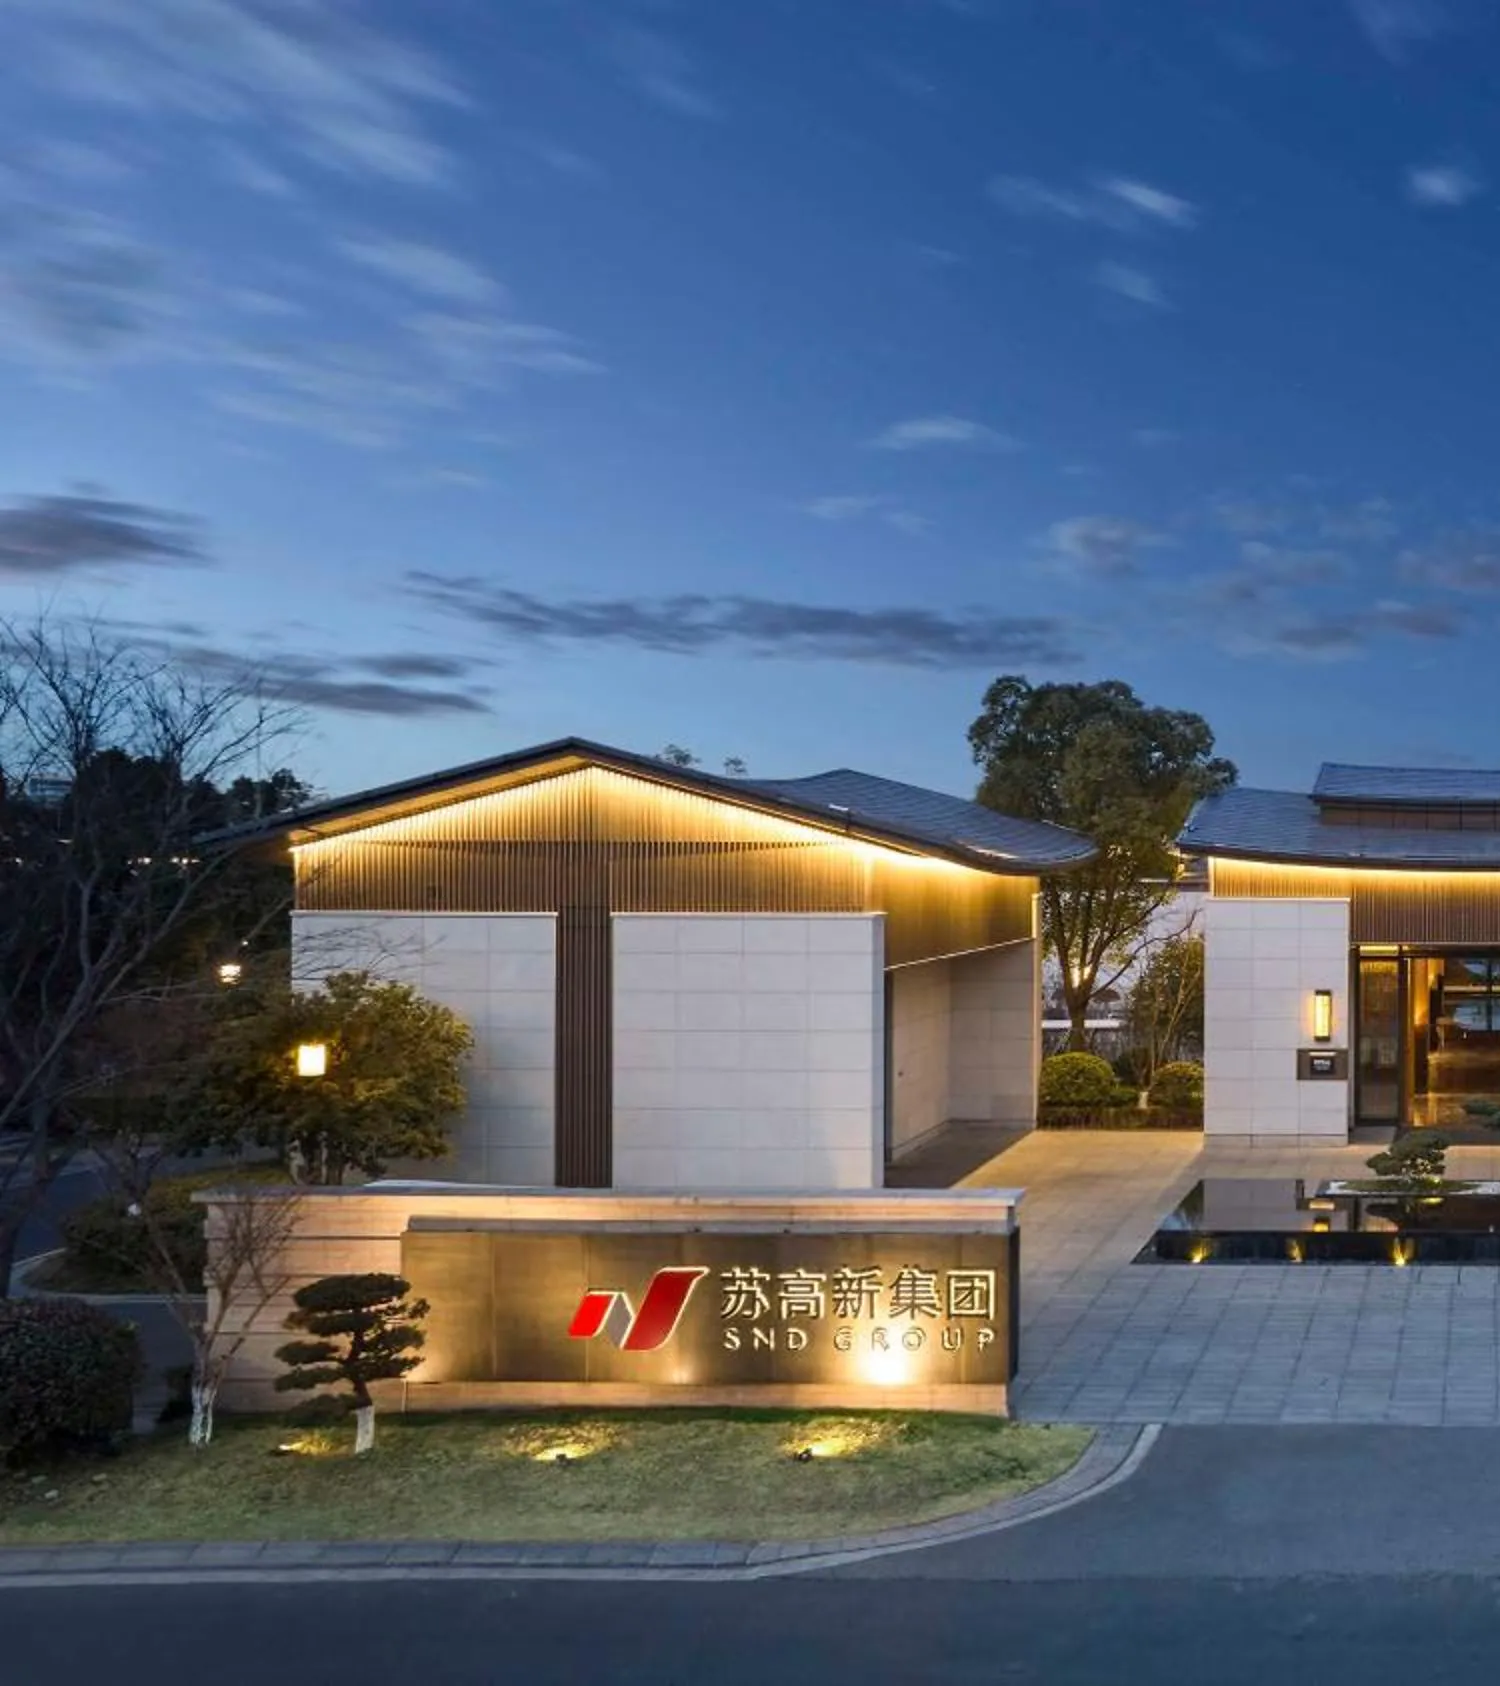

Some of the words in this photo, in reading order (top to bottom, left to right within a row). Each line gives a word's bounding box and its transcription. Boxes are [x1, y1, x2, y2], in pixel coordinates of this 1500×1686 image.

[719, 1265, 996, 1321] 苏高新集团
[722, 1326, 808, 1352] SND
[832, 1325, 996, 1352] GROUP
